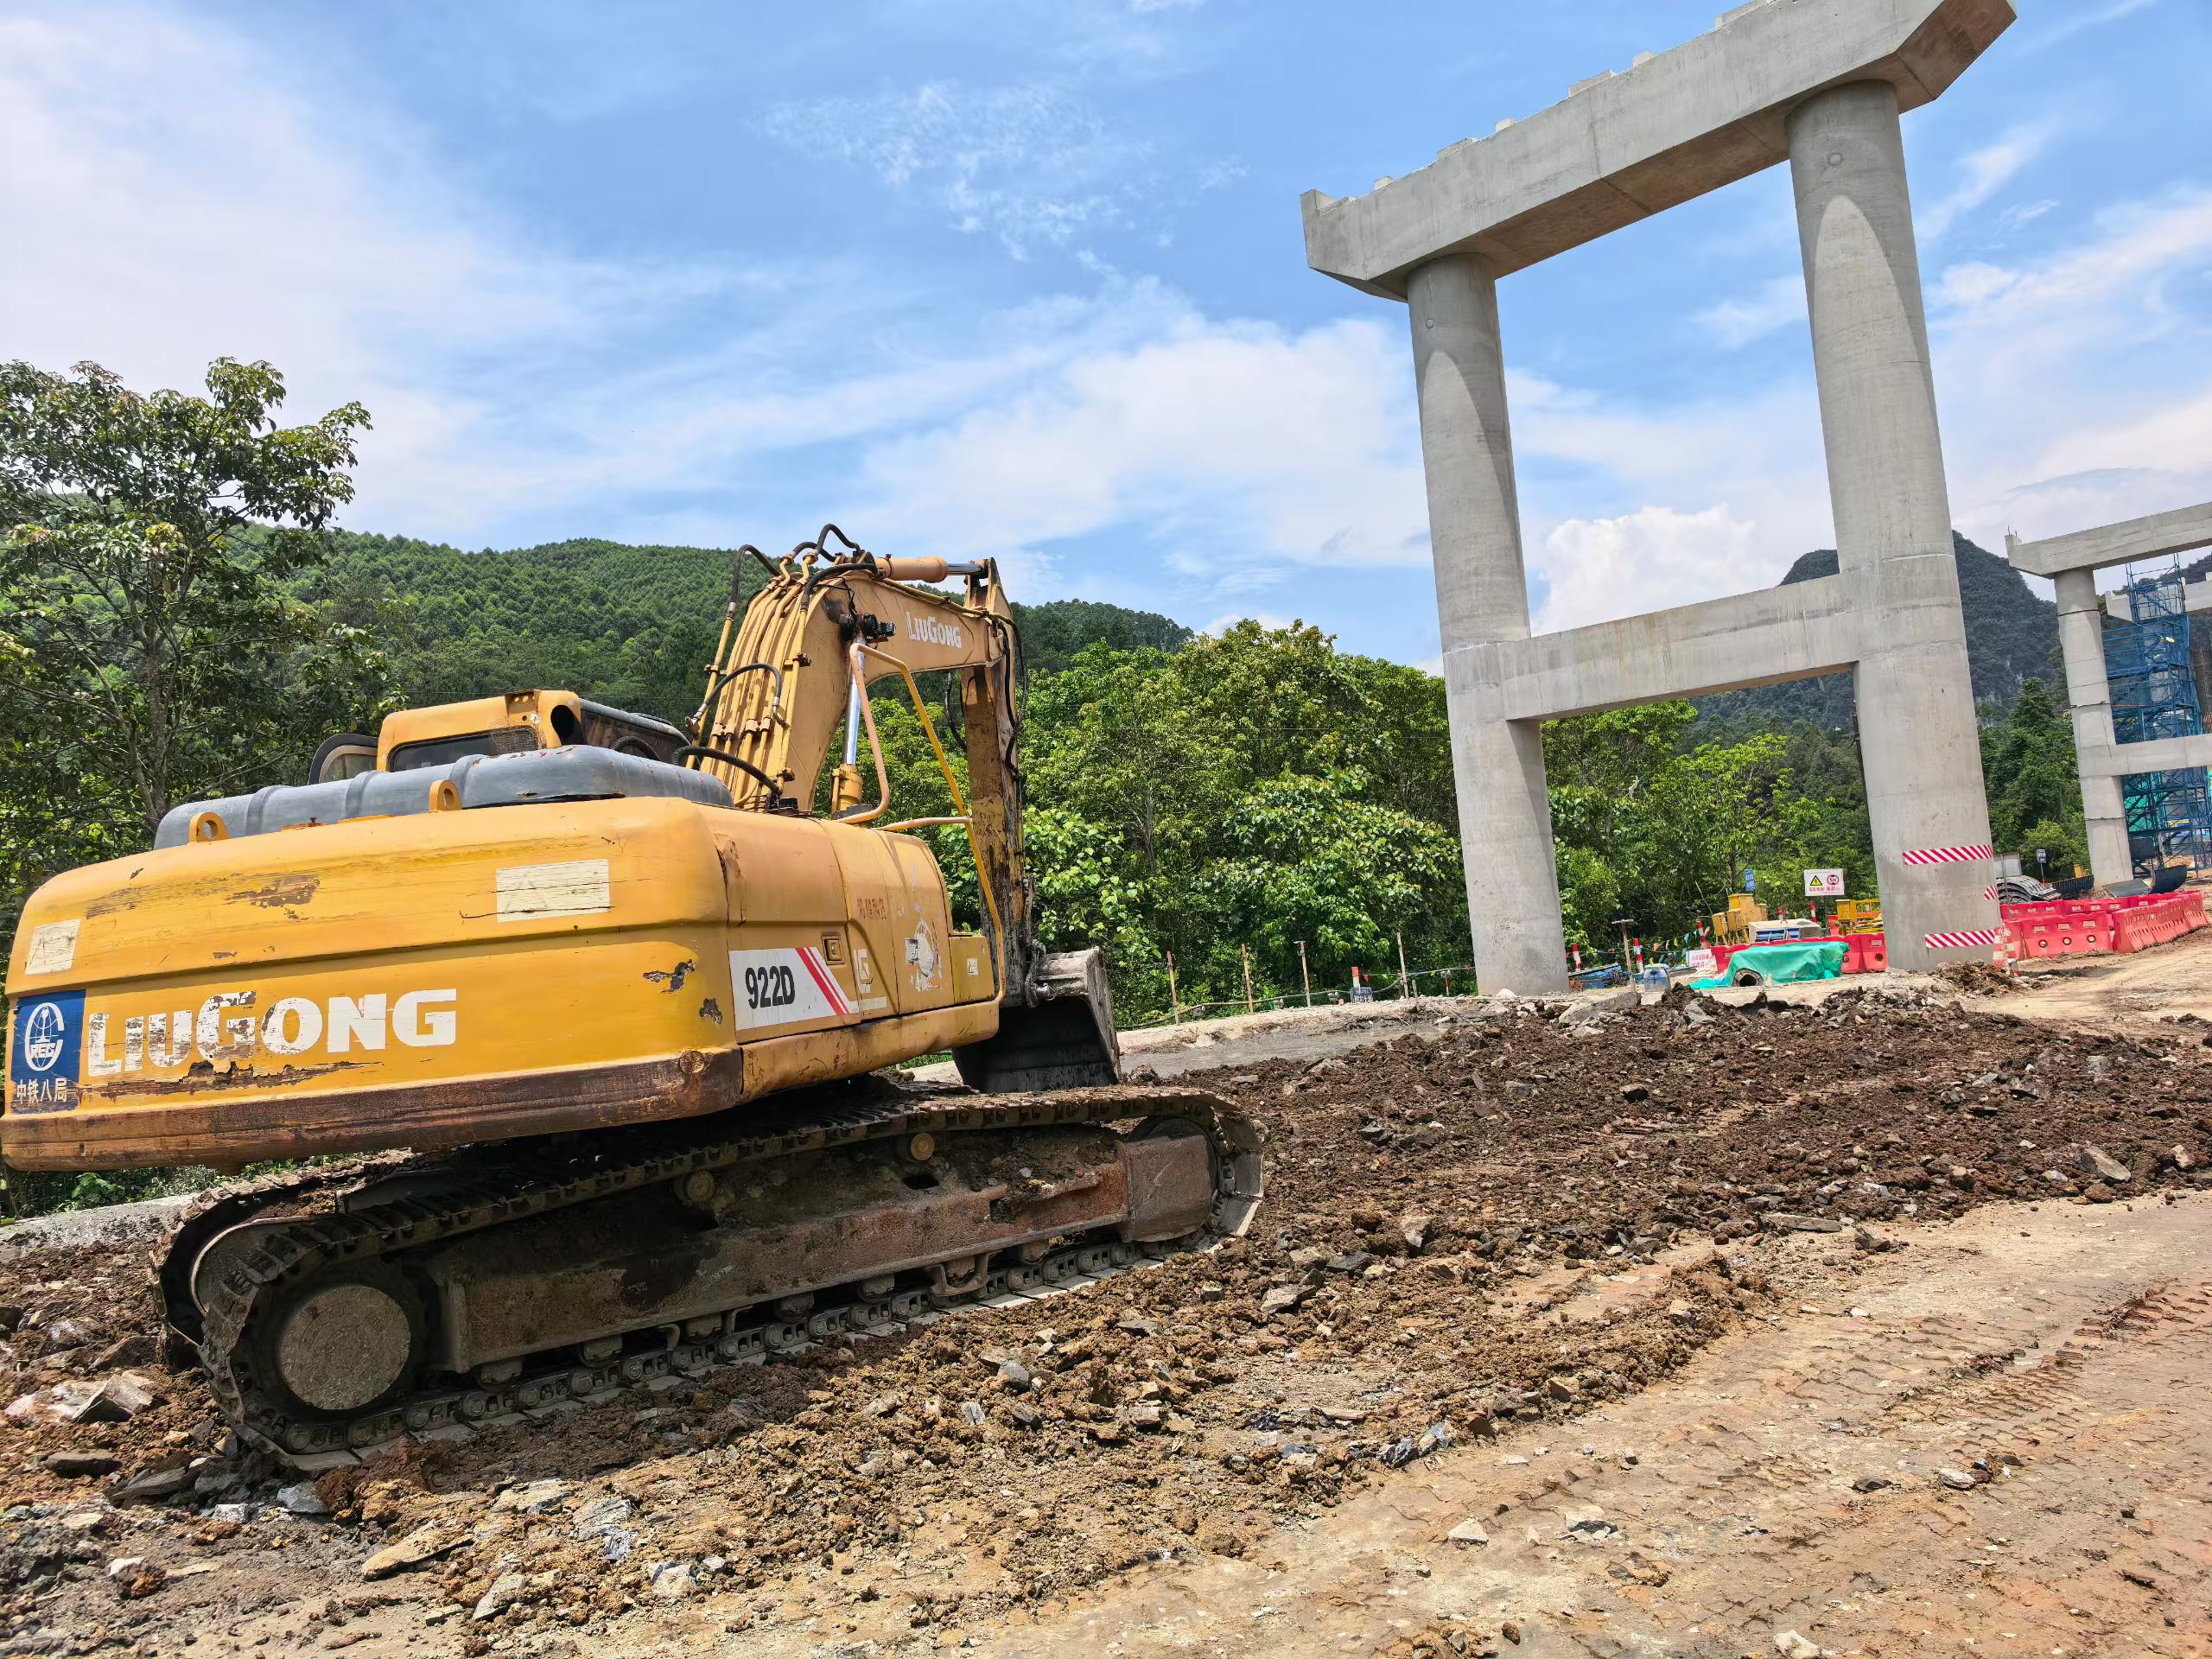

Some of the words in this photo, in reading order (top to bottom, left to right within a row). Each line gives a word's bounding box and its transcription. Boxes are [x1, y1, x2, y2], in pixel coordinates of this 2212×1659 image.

[906, 612, 962, 648] LIUGONG
[745, 966, 796, 1009] 922D
[87, 988, 457, 1077] LIUGONG
[16, 1077, 67, 1104] 中铁八局
